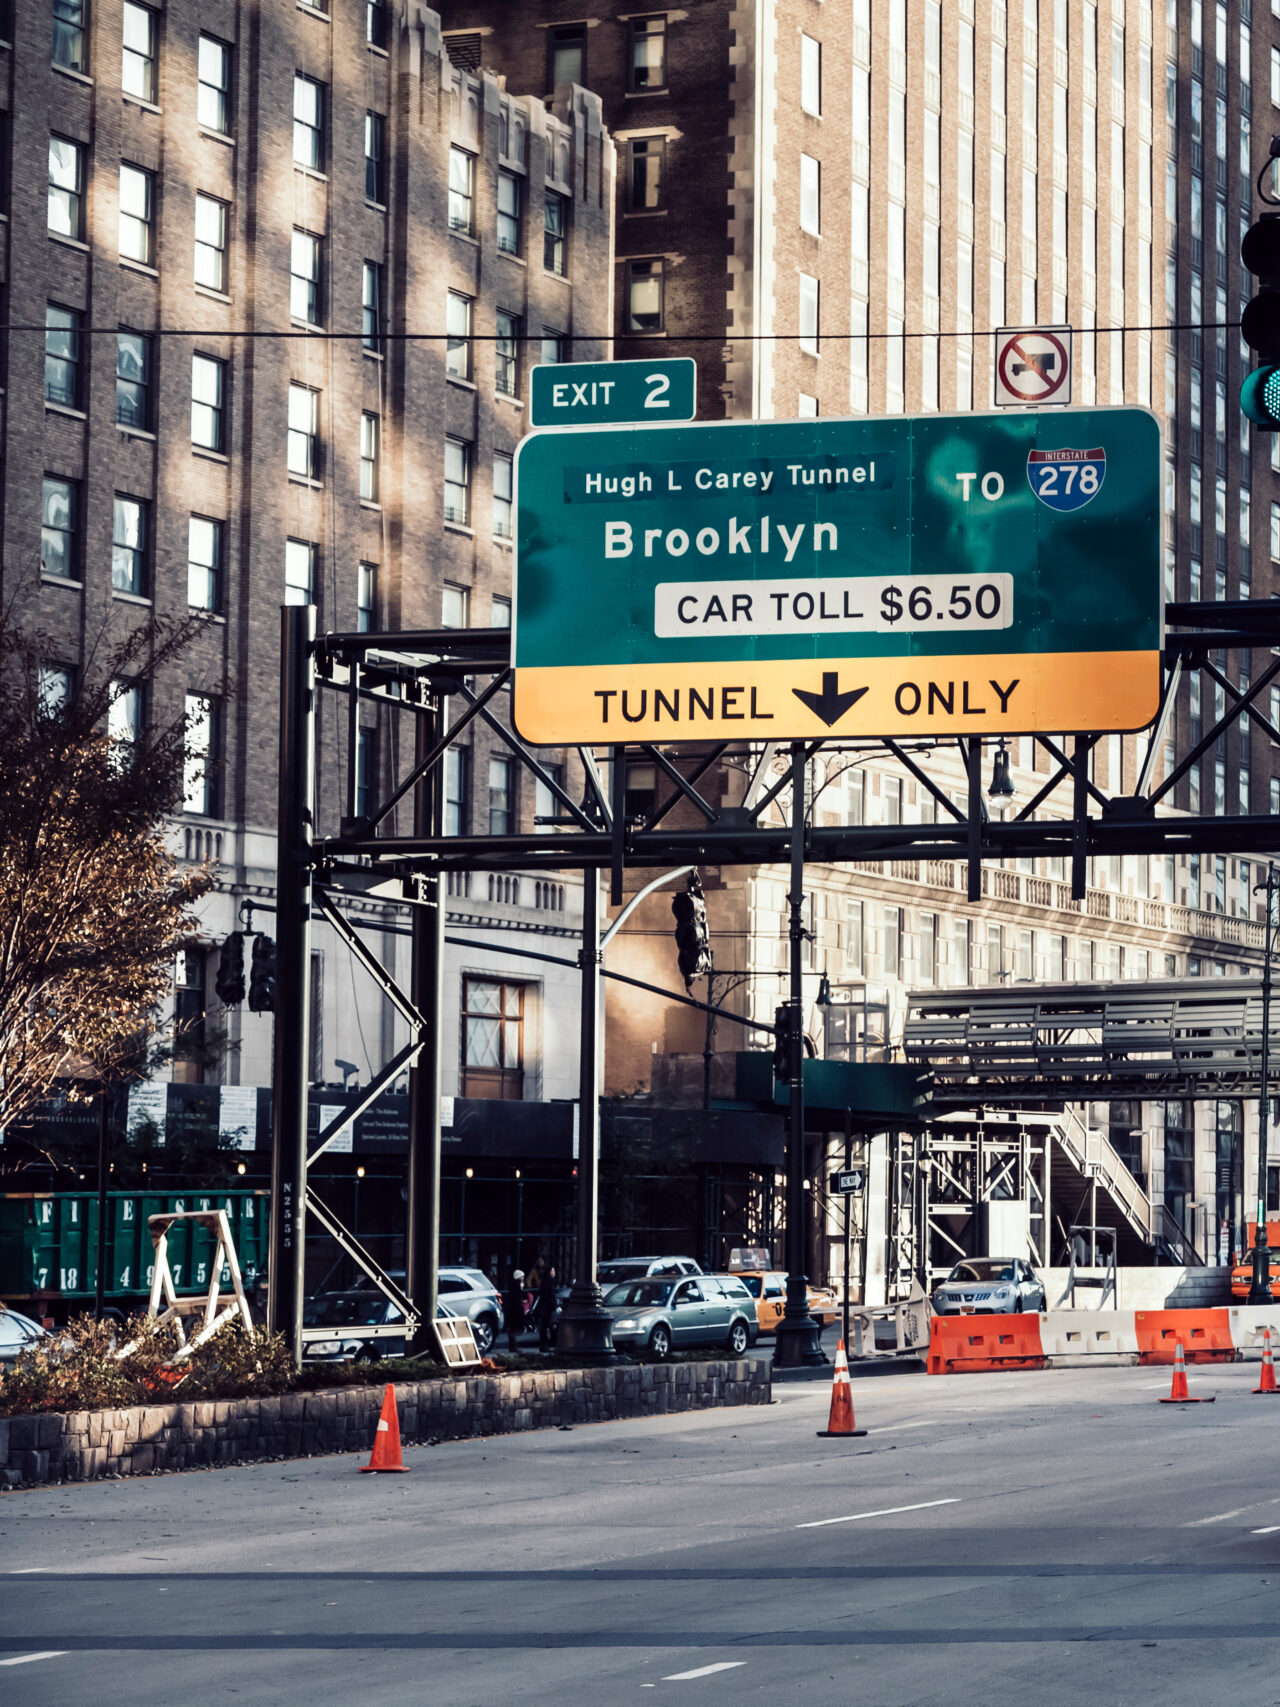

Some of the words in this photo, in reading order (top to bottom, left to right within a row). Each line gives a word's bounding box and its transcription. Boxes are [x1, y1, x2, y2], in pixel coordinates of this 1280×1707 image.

[553, 382, 615, 406] EXIT
[644, 374, 670, 408] 2
[1045, 451, 1089, 461] INTERSTATE
[586, 472, 651, 497] Hugh
[669, 471, 681, 490] L
[695, 469, 773, 490] Carey
[787, 462, 874, 485] Tunnel
[956, 472, 1004, 501] TO
[1039, 466, 1098, 495] 278
[605, 516, 837, 562] Brooklyn
[678, 594, 752, 623] CAR
[770, 591, 863, 620] TOLL
[881, 584, 1000, 625] $6.50
[594, 687, 773, 723] TUNNEL
[895, 680, 1020, 715] ONLY
[41, 1199, 134, 1223] FIE
